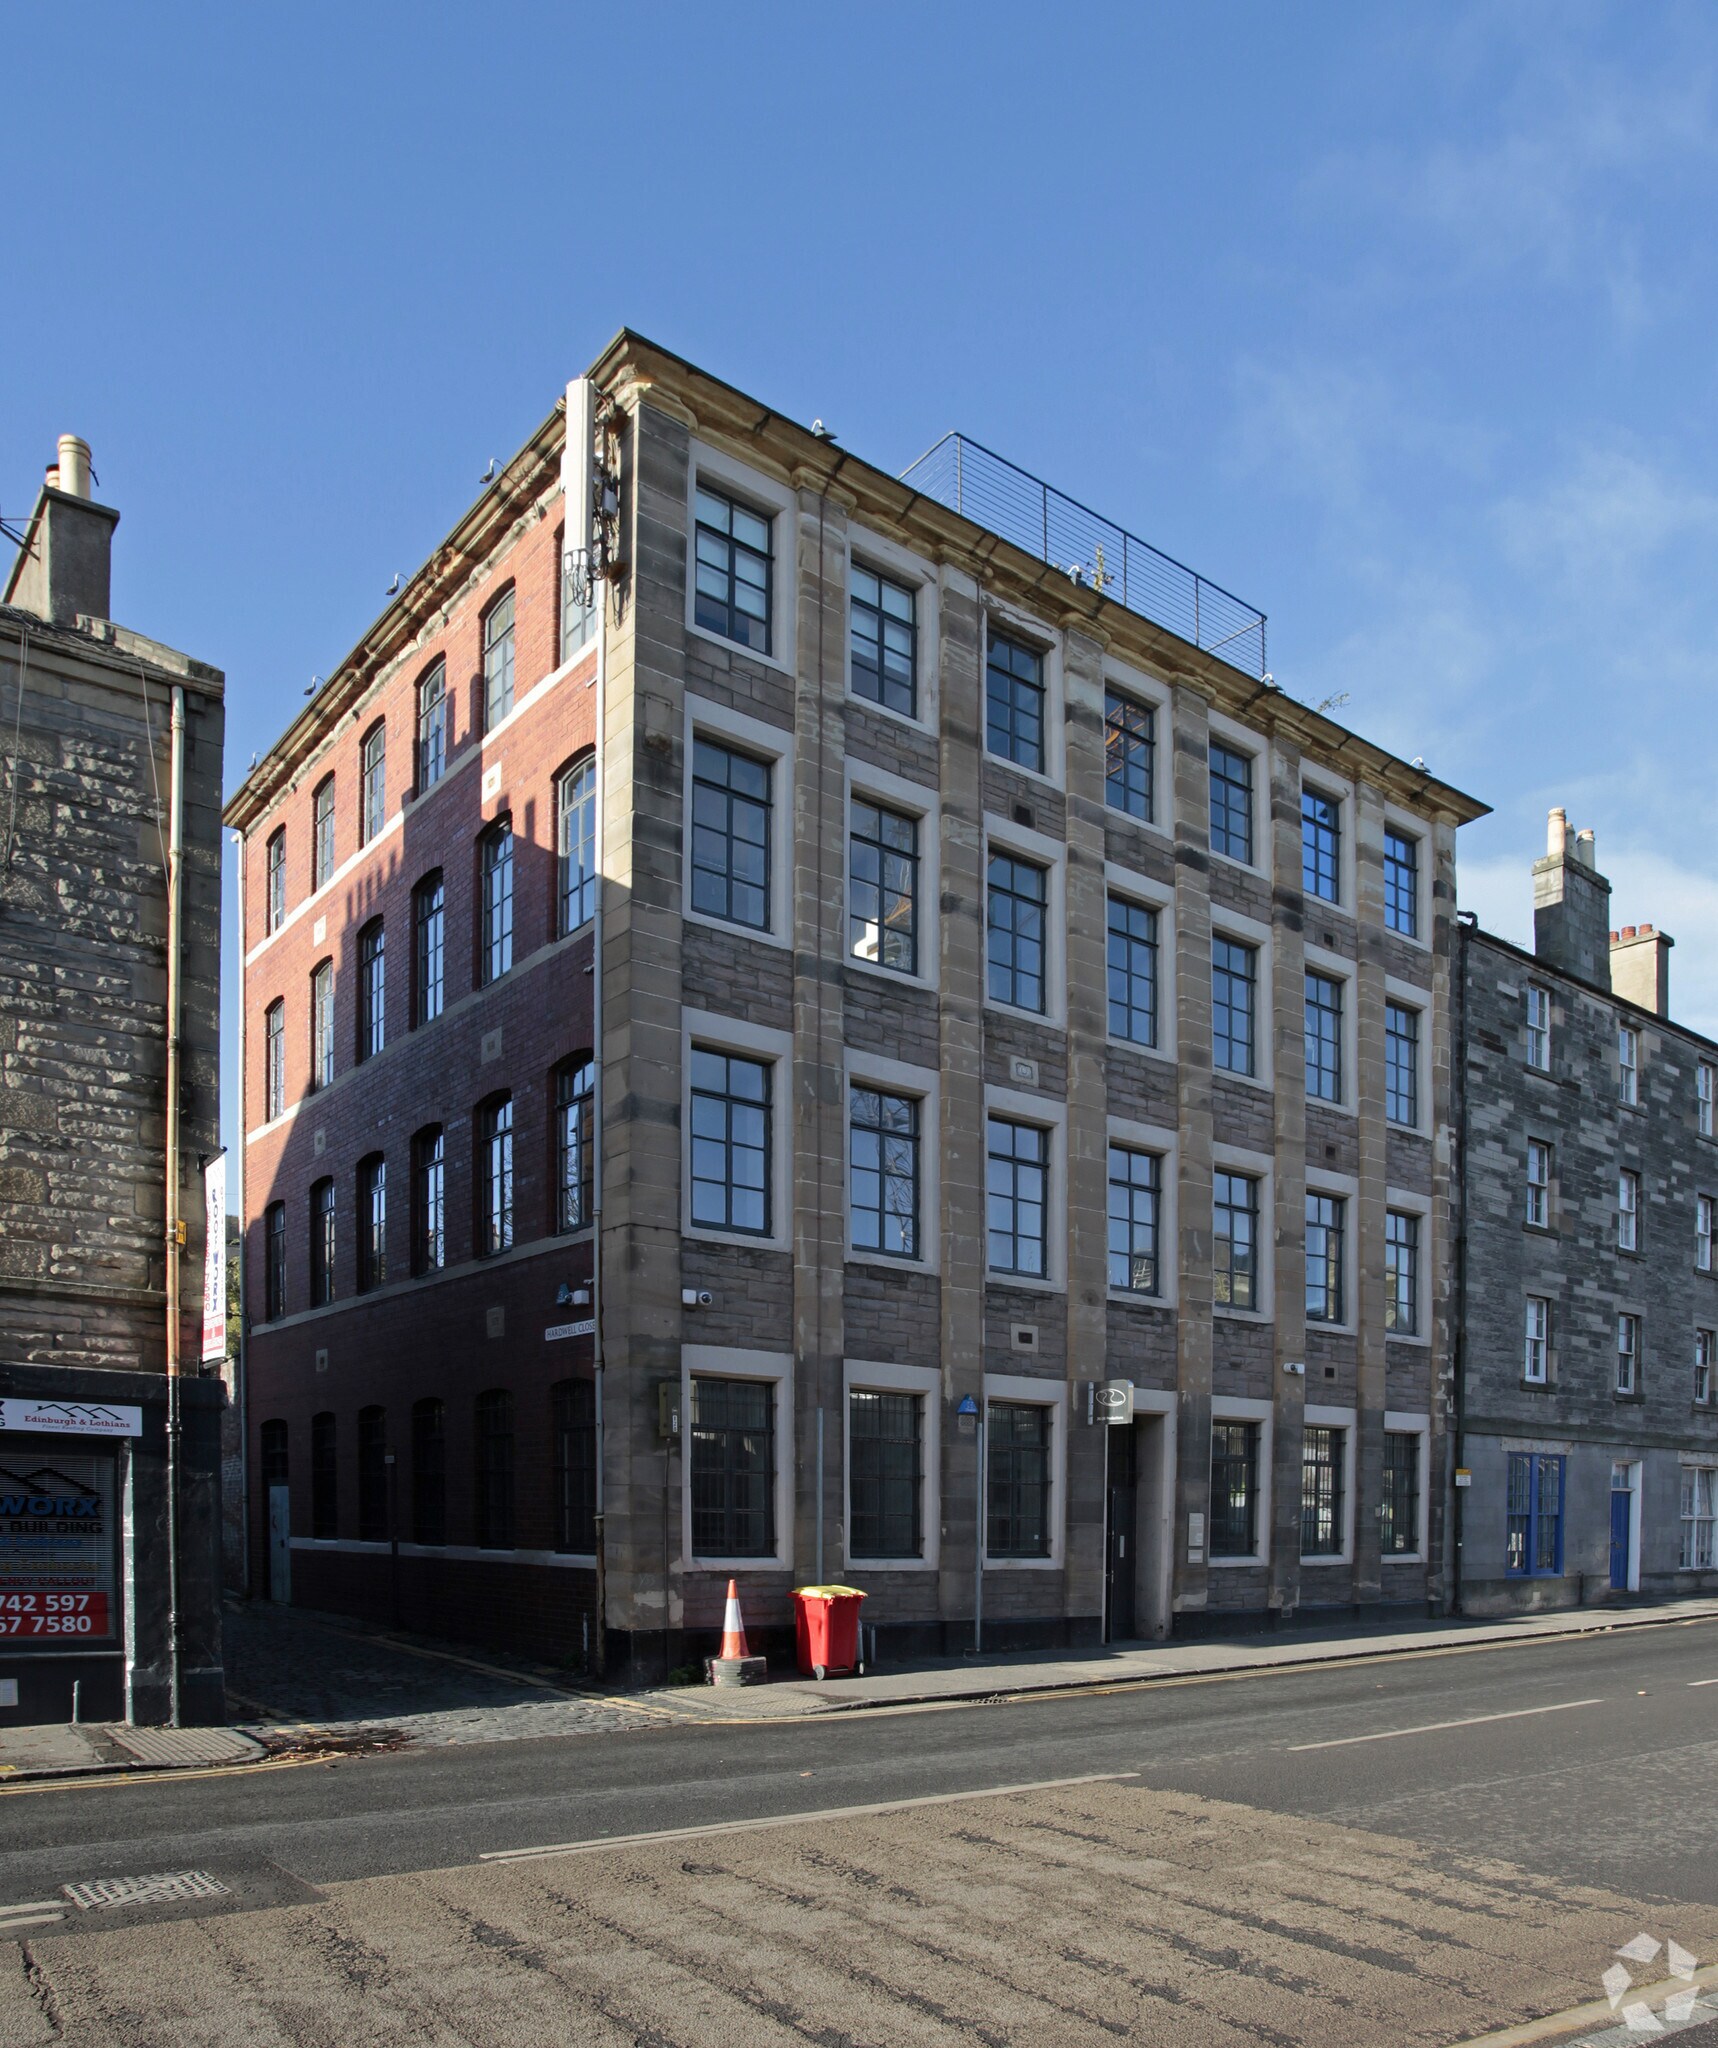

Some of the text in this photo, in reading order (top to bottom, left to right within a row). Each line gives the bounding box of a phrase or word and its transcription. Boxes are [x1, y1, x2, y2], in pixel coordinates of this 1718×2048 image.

[547, 1325, 577, 1338] HARDWELL
[24, 1415, 77, 1425] Edinburgh
[90, 1420, 130, 1428] Lothians
[45, 1594, 89, 1612] 597
[30, 1615, 92, 1633] 7580
